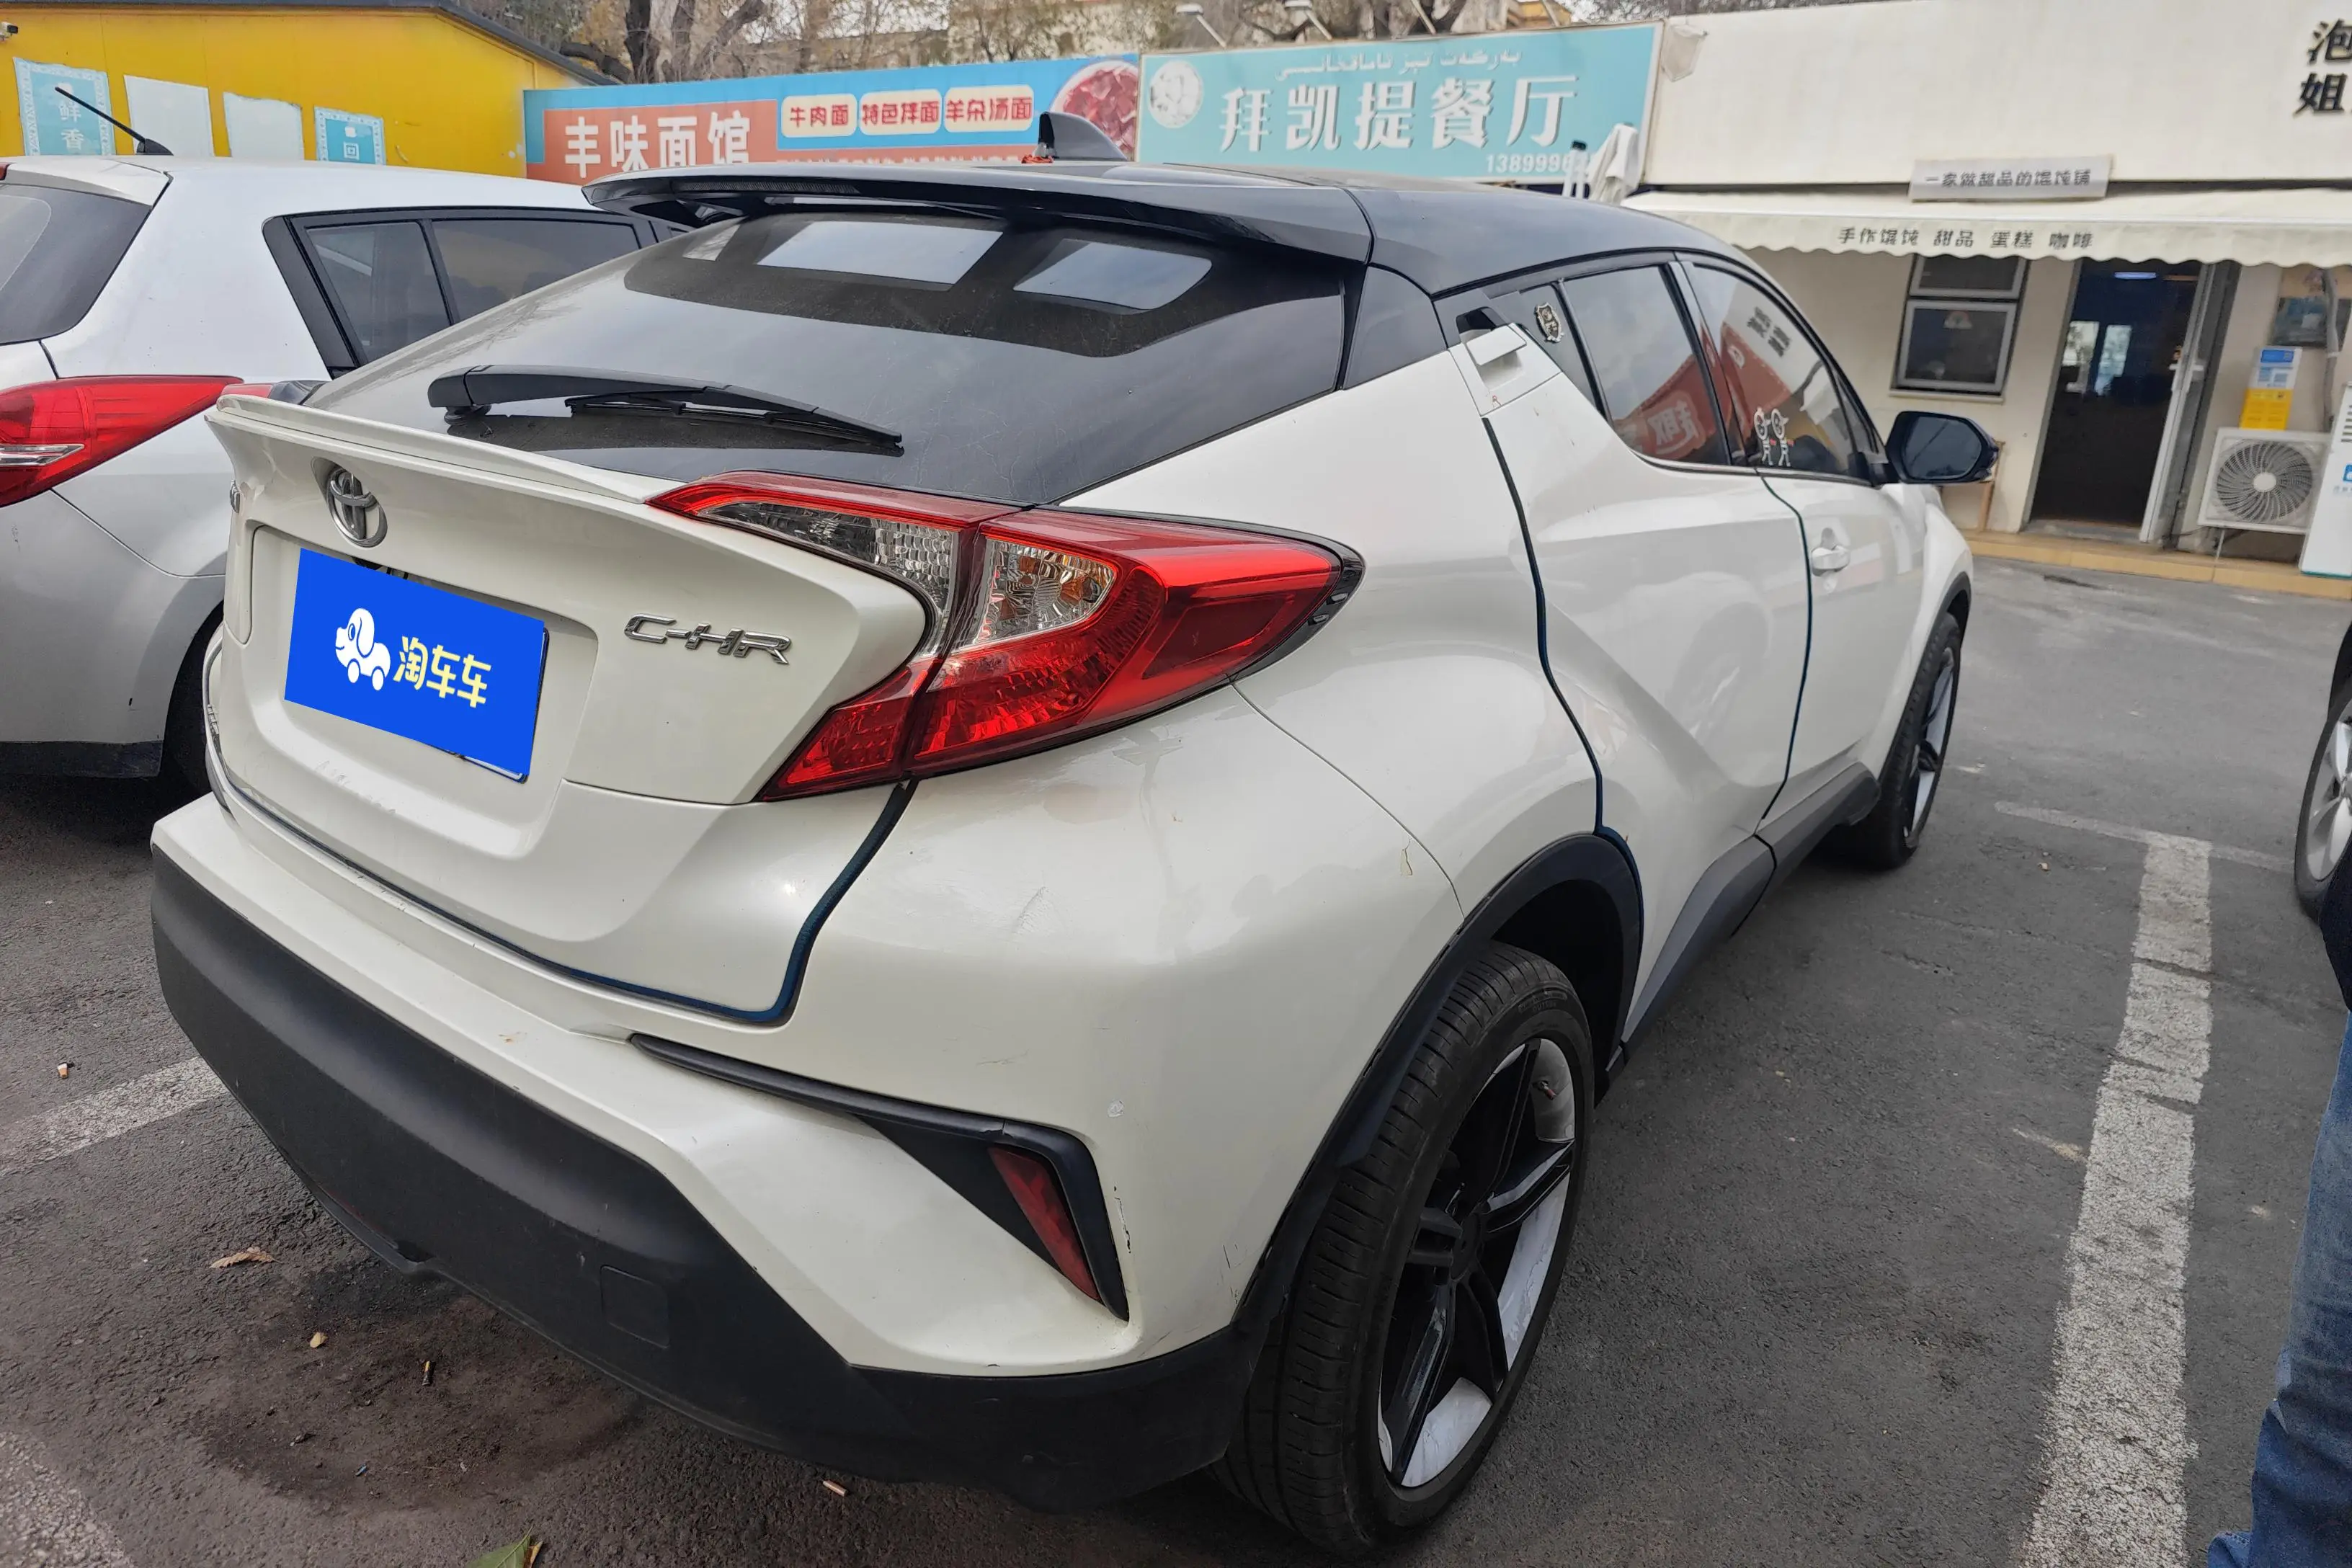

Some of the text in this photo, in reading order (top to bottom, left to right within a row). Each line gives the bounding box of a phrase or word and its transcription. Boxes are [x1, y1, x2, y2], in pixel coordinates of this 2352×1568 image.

[862, 100, 940, 126] 特色拌面
[945, 97, 1032, 122] 羊杂汤面
[2291, 72, 2347, 118] 姐
[790, 104, 848, 128] 牛肉面
[1220, 75, 1578, 152] 拜凯提餐厅
[565, 110, 750, 179] 丰味面馆
[1838, 227, 2093, 249] 手作馄饨 甜品 蛋糕 咖啡
[624, 613, 791, 665] C-HR
